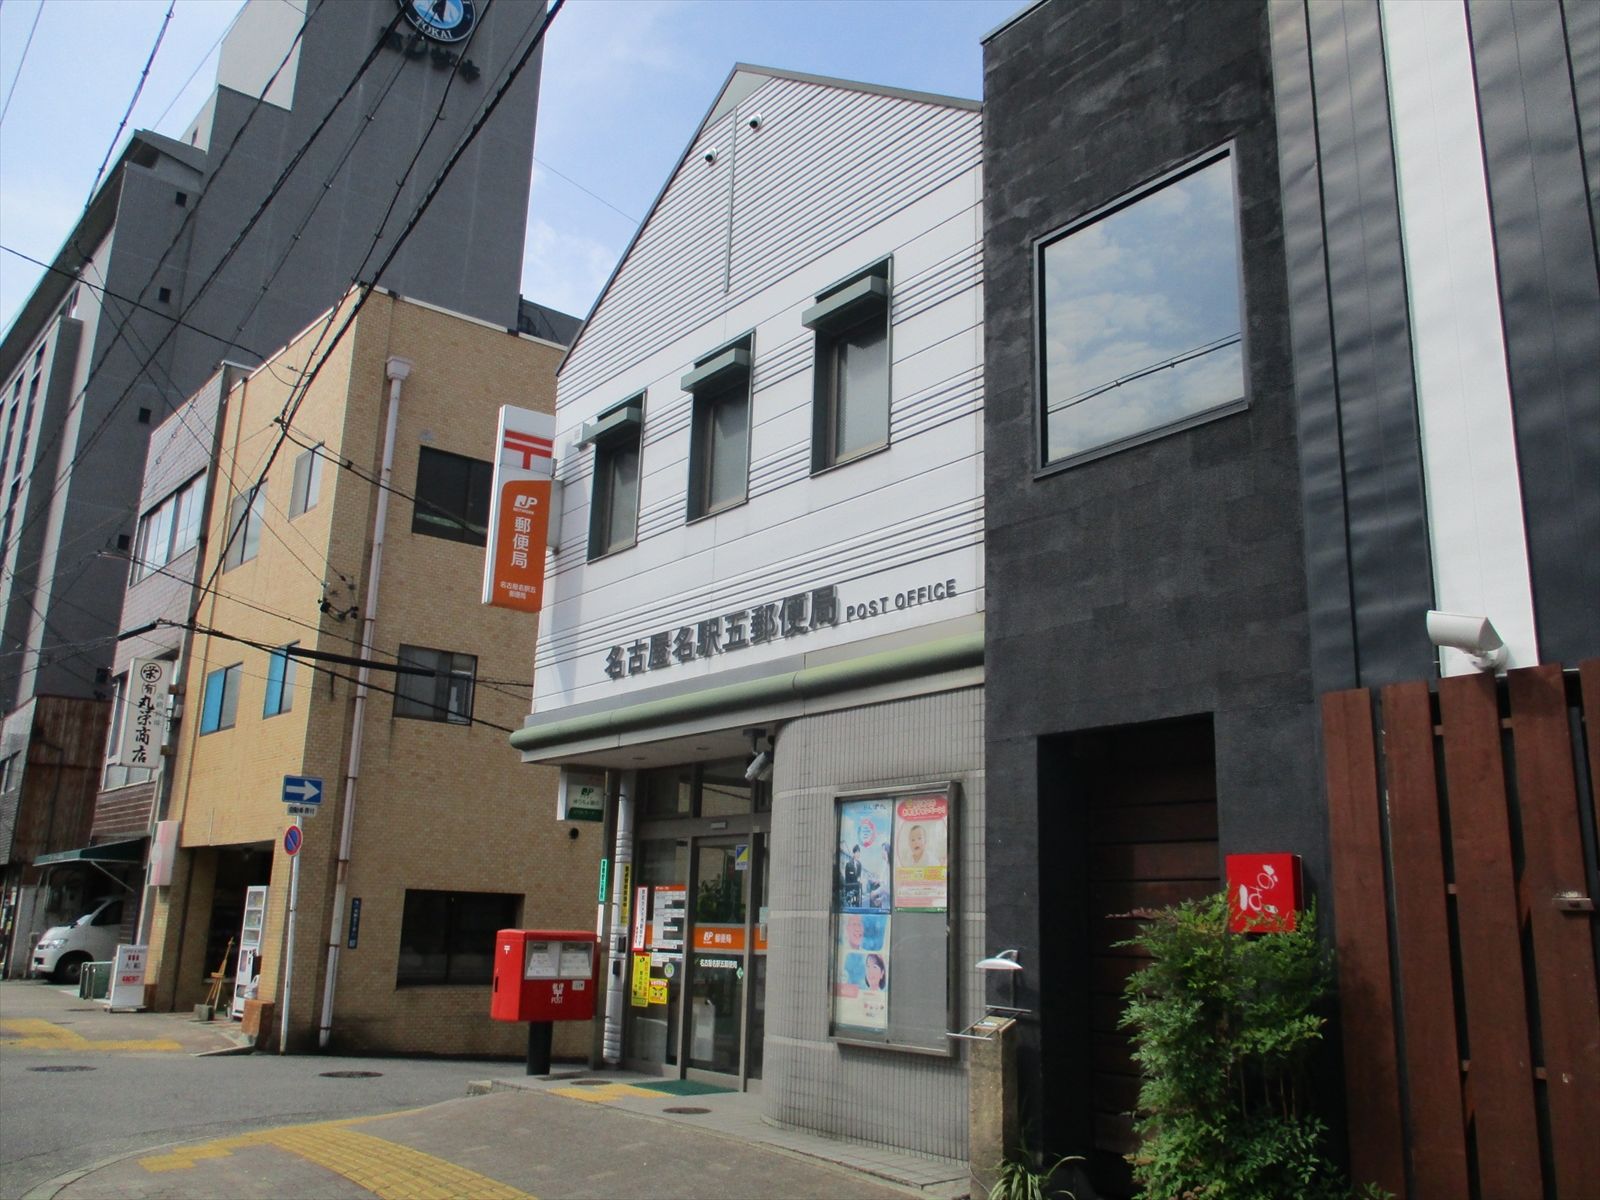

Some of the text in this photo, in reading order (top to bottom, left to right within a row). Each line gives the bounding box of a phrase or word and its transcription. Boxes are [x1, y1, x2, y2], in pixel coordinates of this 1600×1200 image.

[415, 16, 454, 39] TOKAI
[511, 516, 532, 569] 郵便局
[846, 579, 957, 622] POST OFFICE
[605, 584, 841, 679] 名古屋名駅五郵便局
